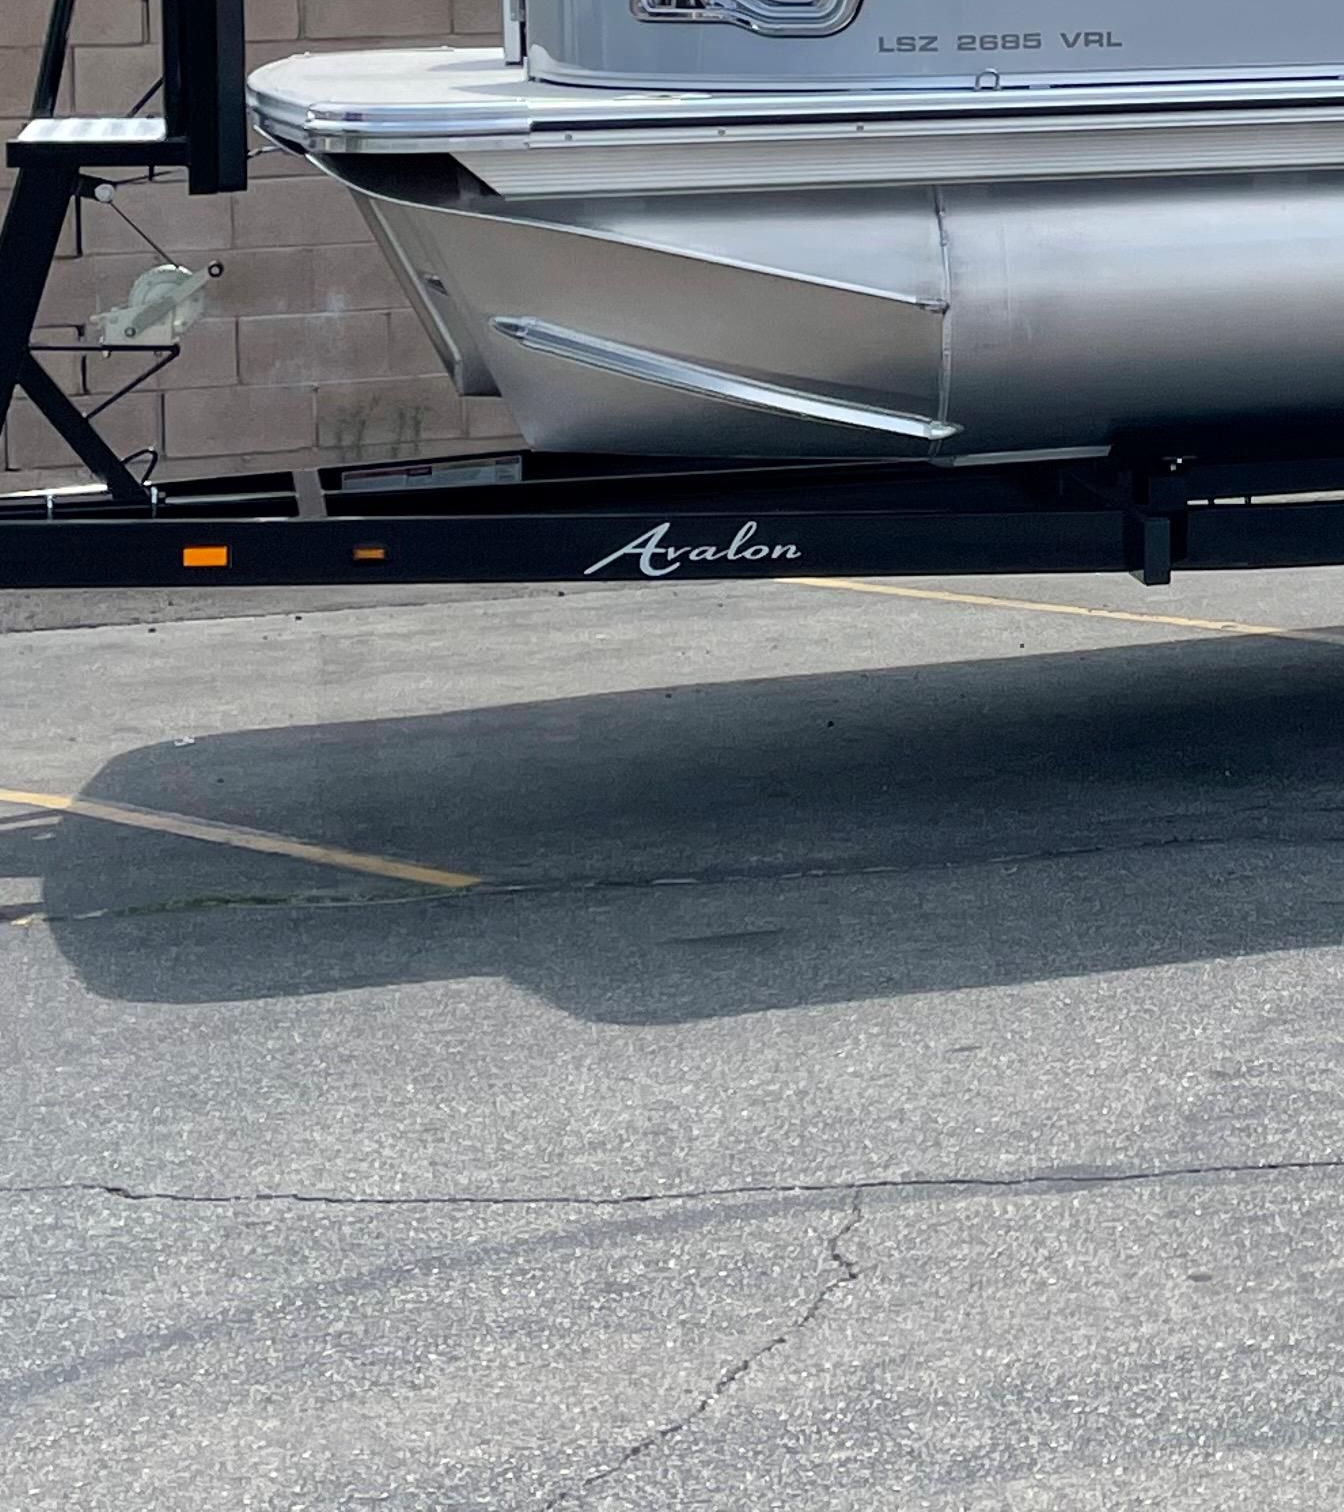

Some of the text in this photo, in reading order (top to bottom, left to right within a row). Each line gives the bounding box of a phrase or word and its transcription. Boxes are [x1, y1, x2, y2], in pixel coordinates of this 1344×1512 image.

[878, 31, 1123, 53] LSZ 2685 VRL
[583, 521, 802, 577] Avalon
